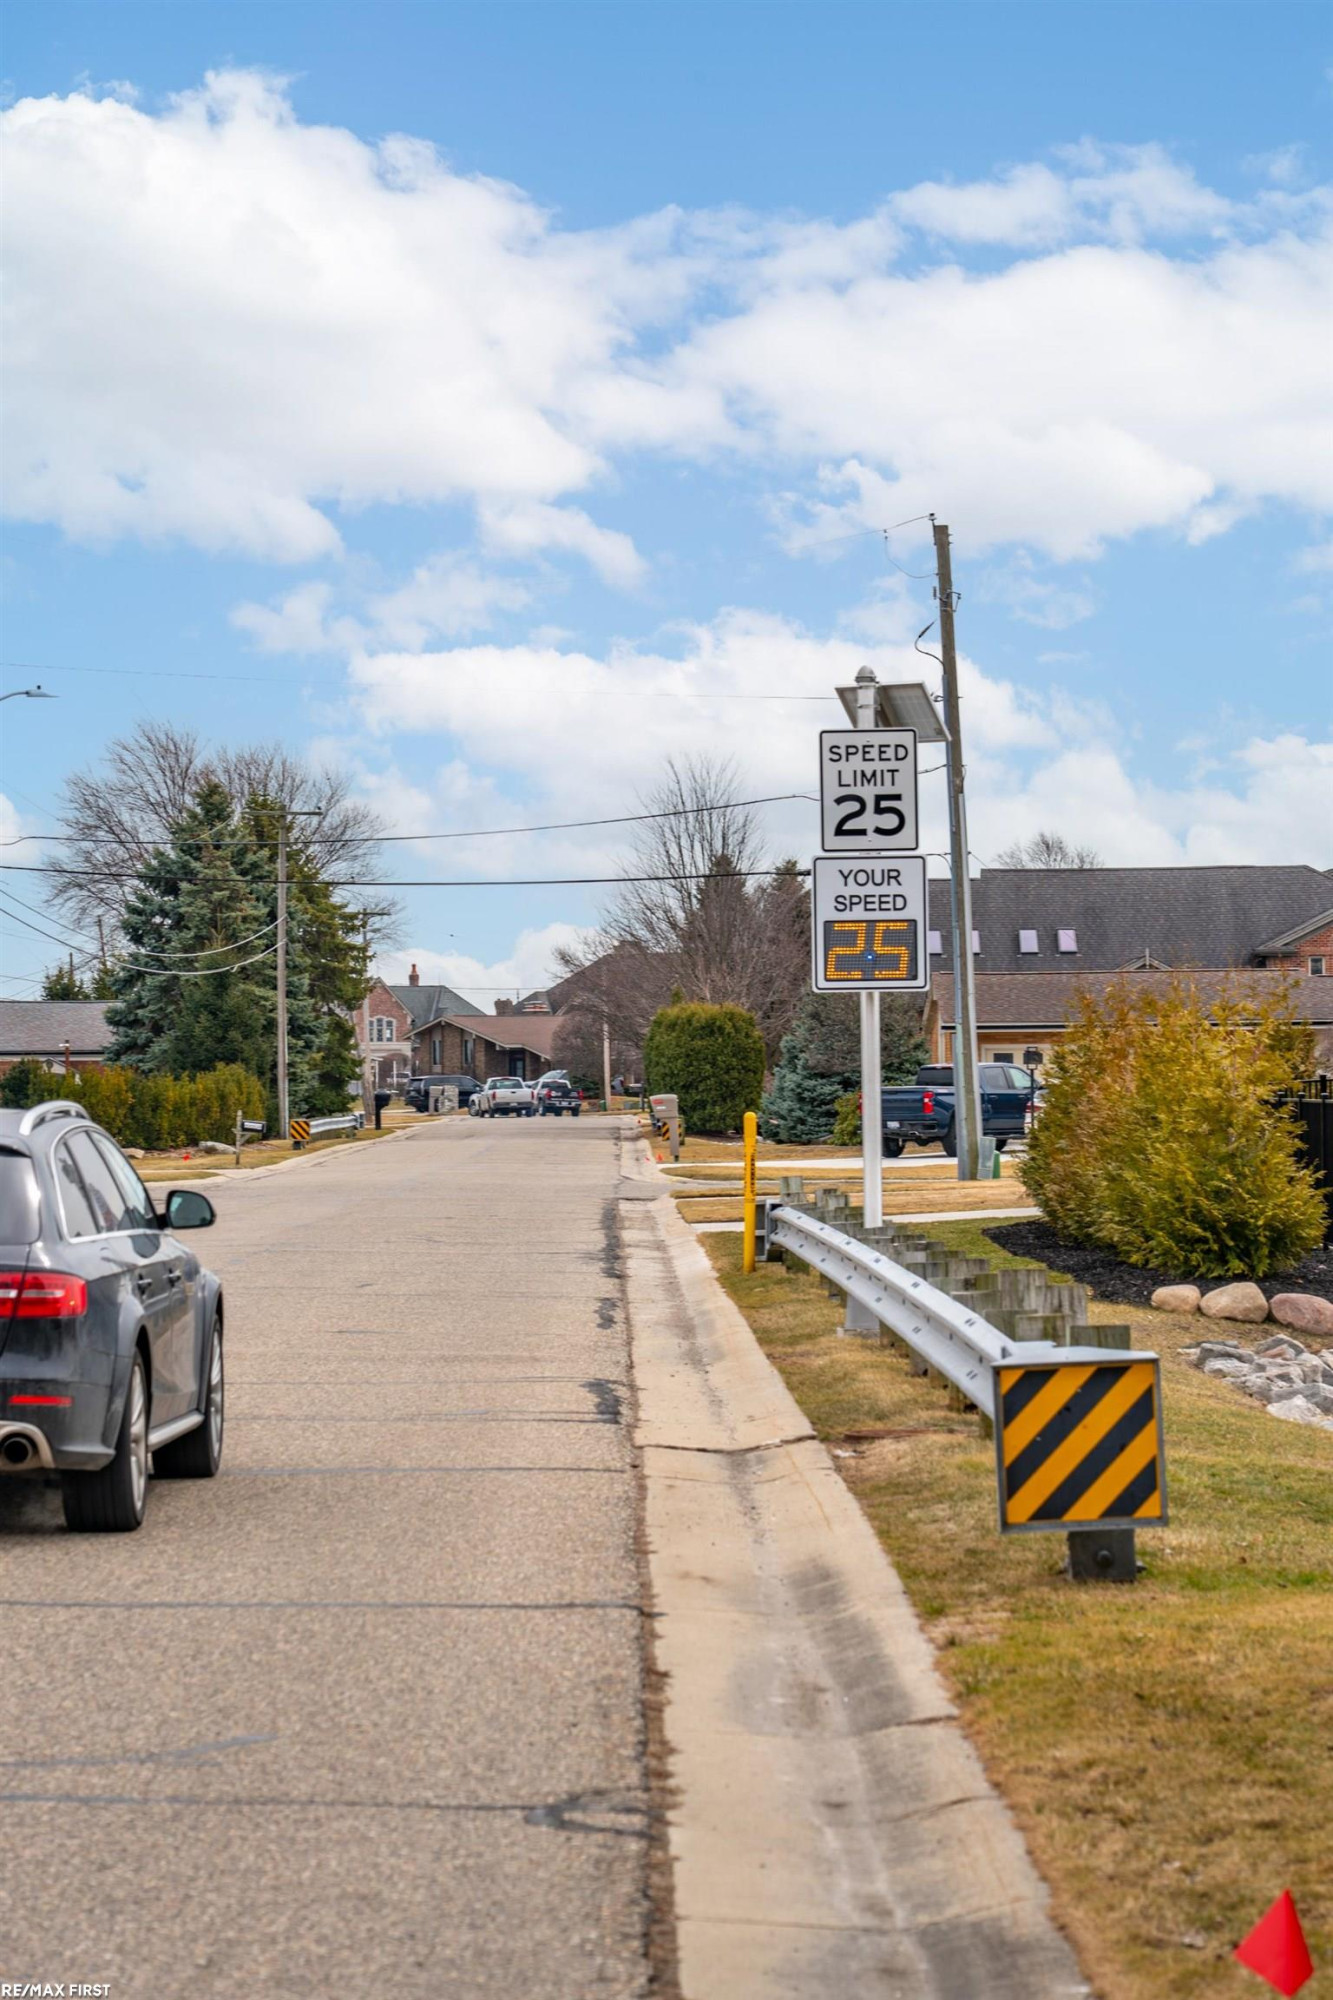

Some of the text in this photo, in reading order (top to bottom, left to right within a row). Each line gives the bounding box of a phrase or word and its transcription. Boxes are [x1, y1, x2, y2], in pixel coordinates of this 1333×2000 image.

[828, 744, 908, 762] SPEED
[838, 769, 899, 788] LIMIT
[833, 793, 906, 836] 25
[838, 869, 902, 887] YOUR
[833, 894, 907, 912] SPEED
[826, 922, 909, 979] 25
